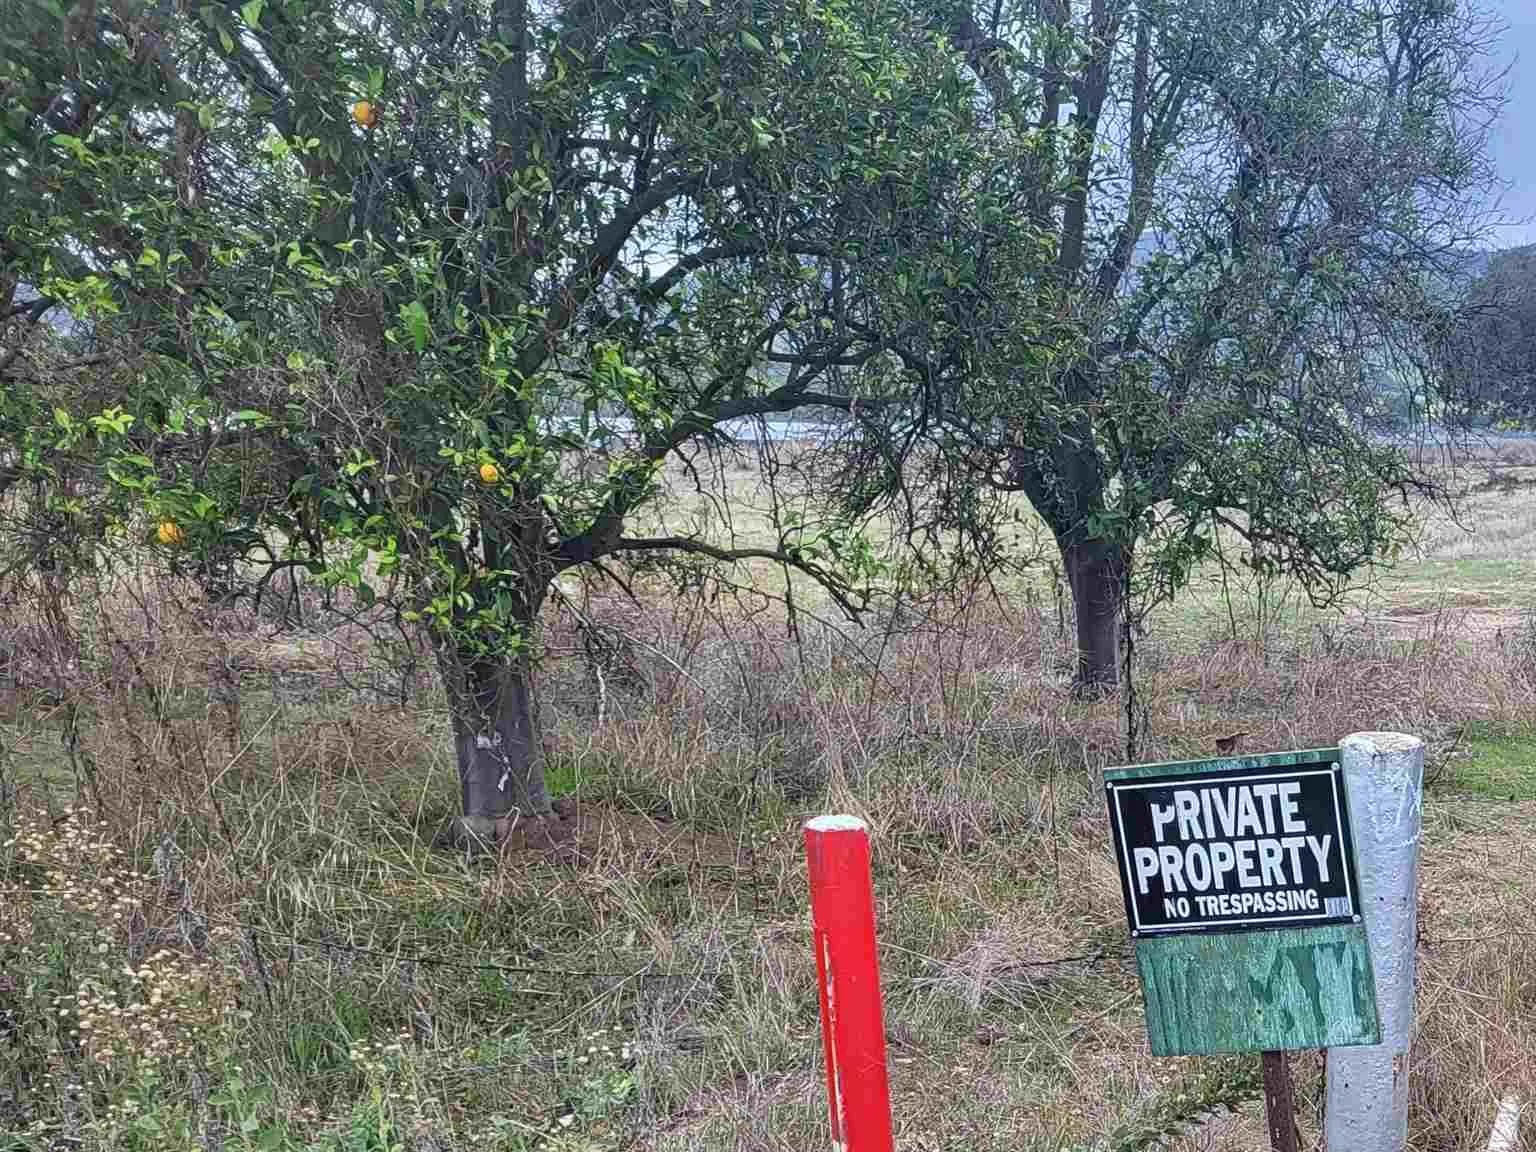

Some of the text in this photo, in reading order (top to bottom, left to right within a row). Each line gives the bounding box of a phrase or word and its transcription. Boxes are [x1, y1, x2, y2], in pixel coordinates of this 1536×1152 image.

[1150, 781, 1306, 842] PRIVATE
[1133, 834, 1332, 895] PROPERTY
[1163, 888, 1320, 919] NO TRESPASSING
